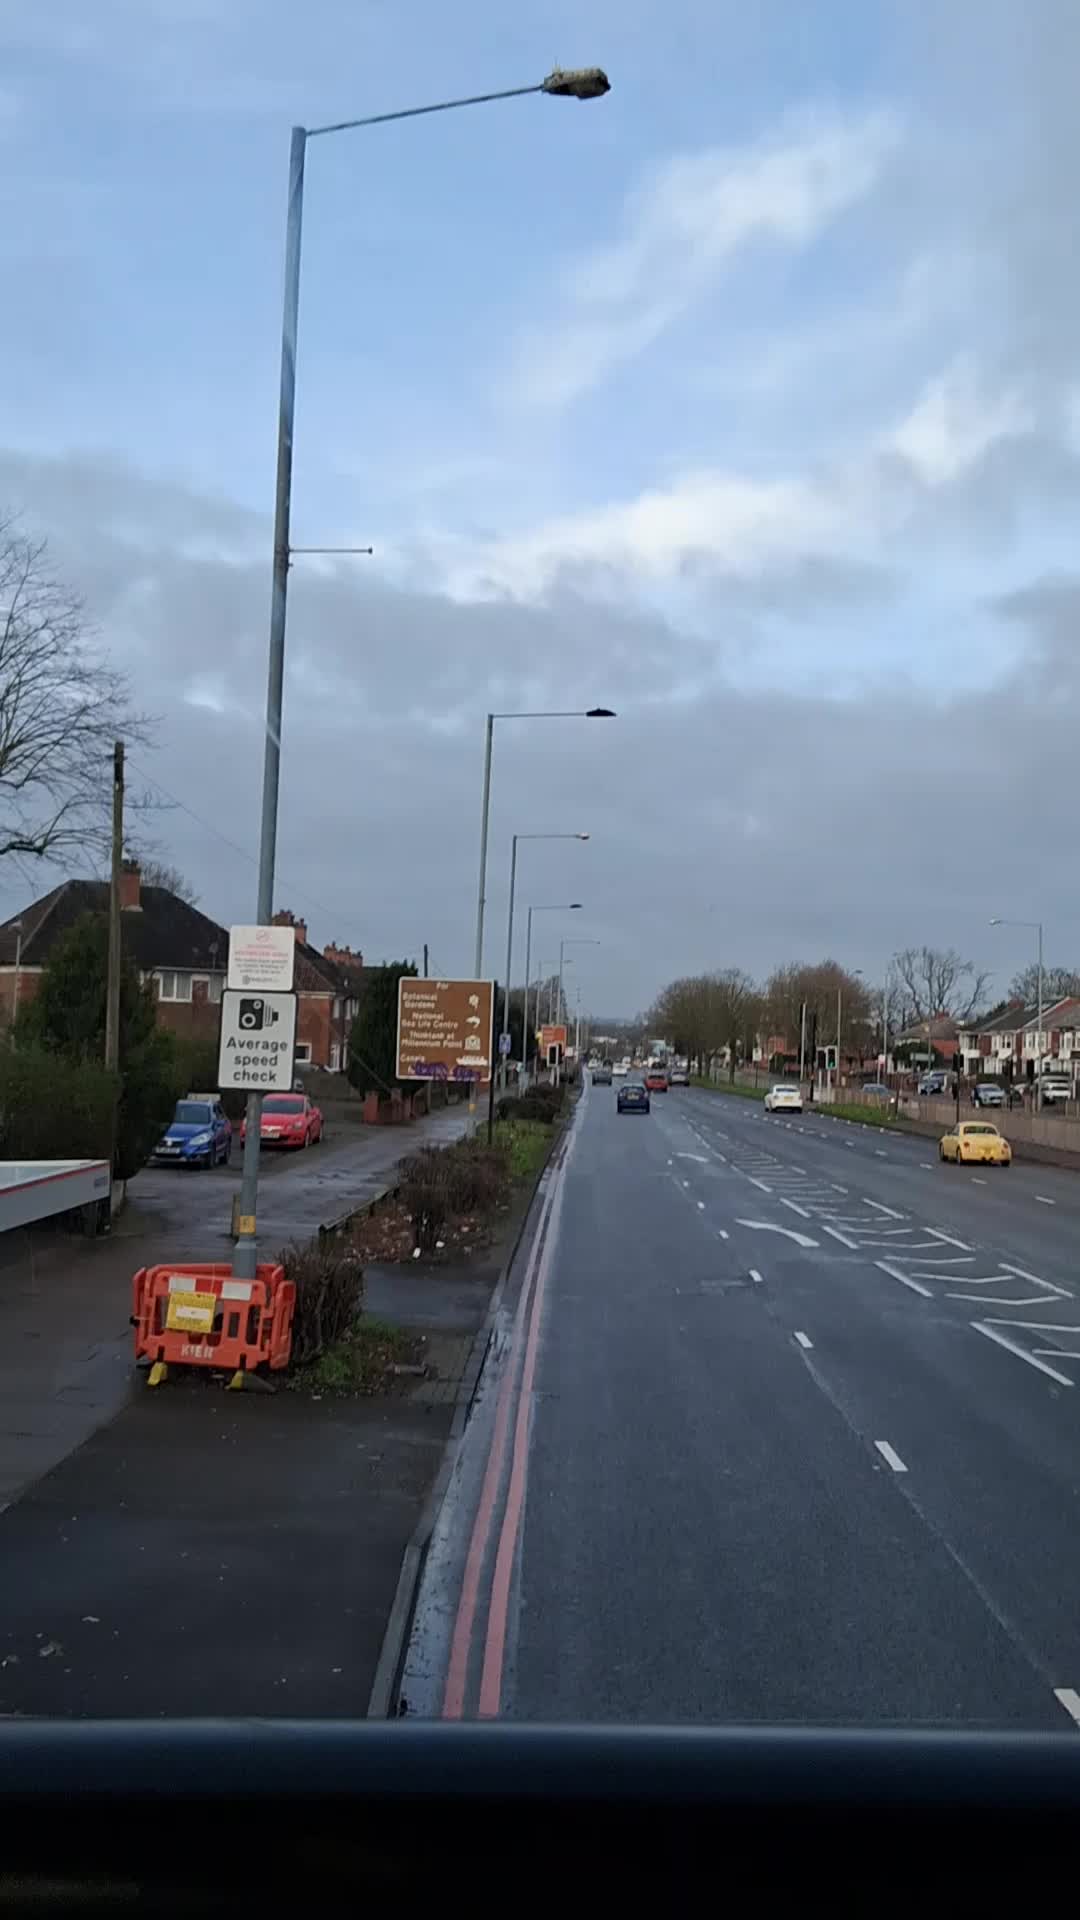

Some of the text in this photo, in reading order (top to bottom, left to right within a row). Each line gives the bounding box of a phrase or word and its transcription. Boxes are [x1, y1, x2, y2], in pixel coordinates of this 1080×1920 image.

[402, 993, 437, 1001] Botanical
[418, 1020, 431, 1029] Life
[433, 1020, 459, 1029] Centre
[226, 1037, 288, 1053] Average
[234, 1054, 279, 1068] speed
[233, 1069, 277, 1083] check
[181, 1344, 215, 1359] KIER
